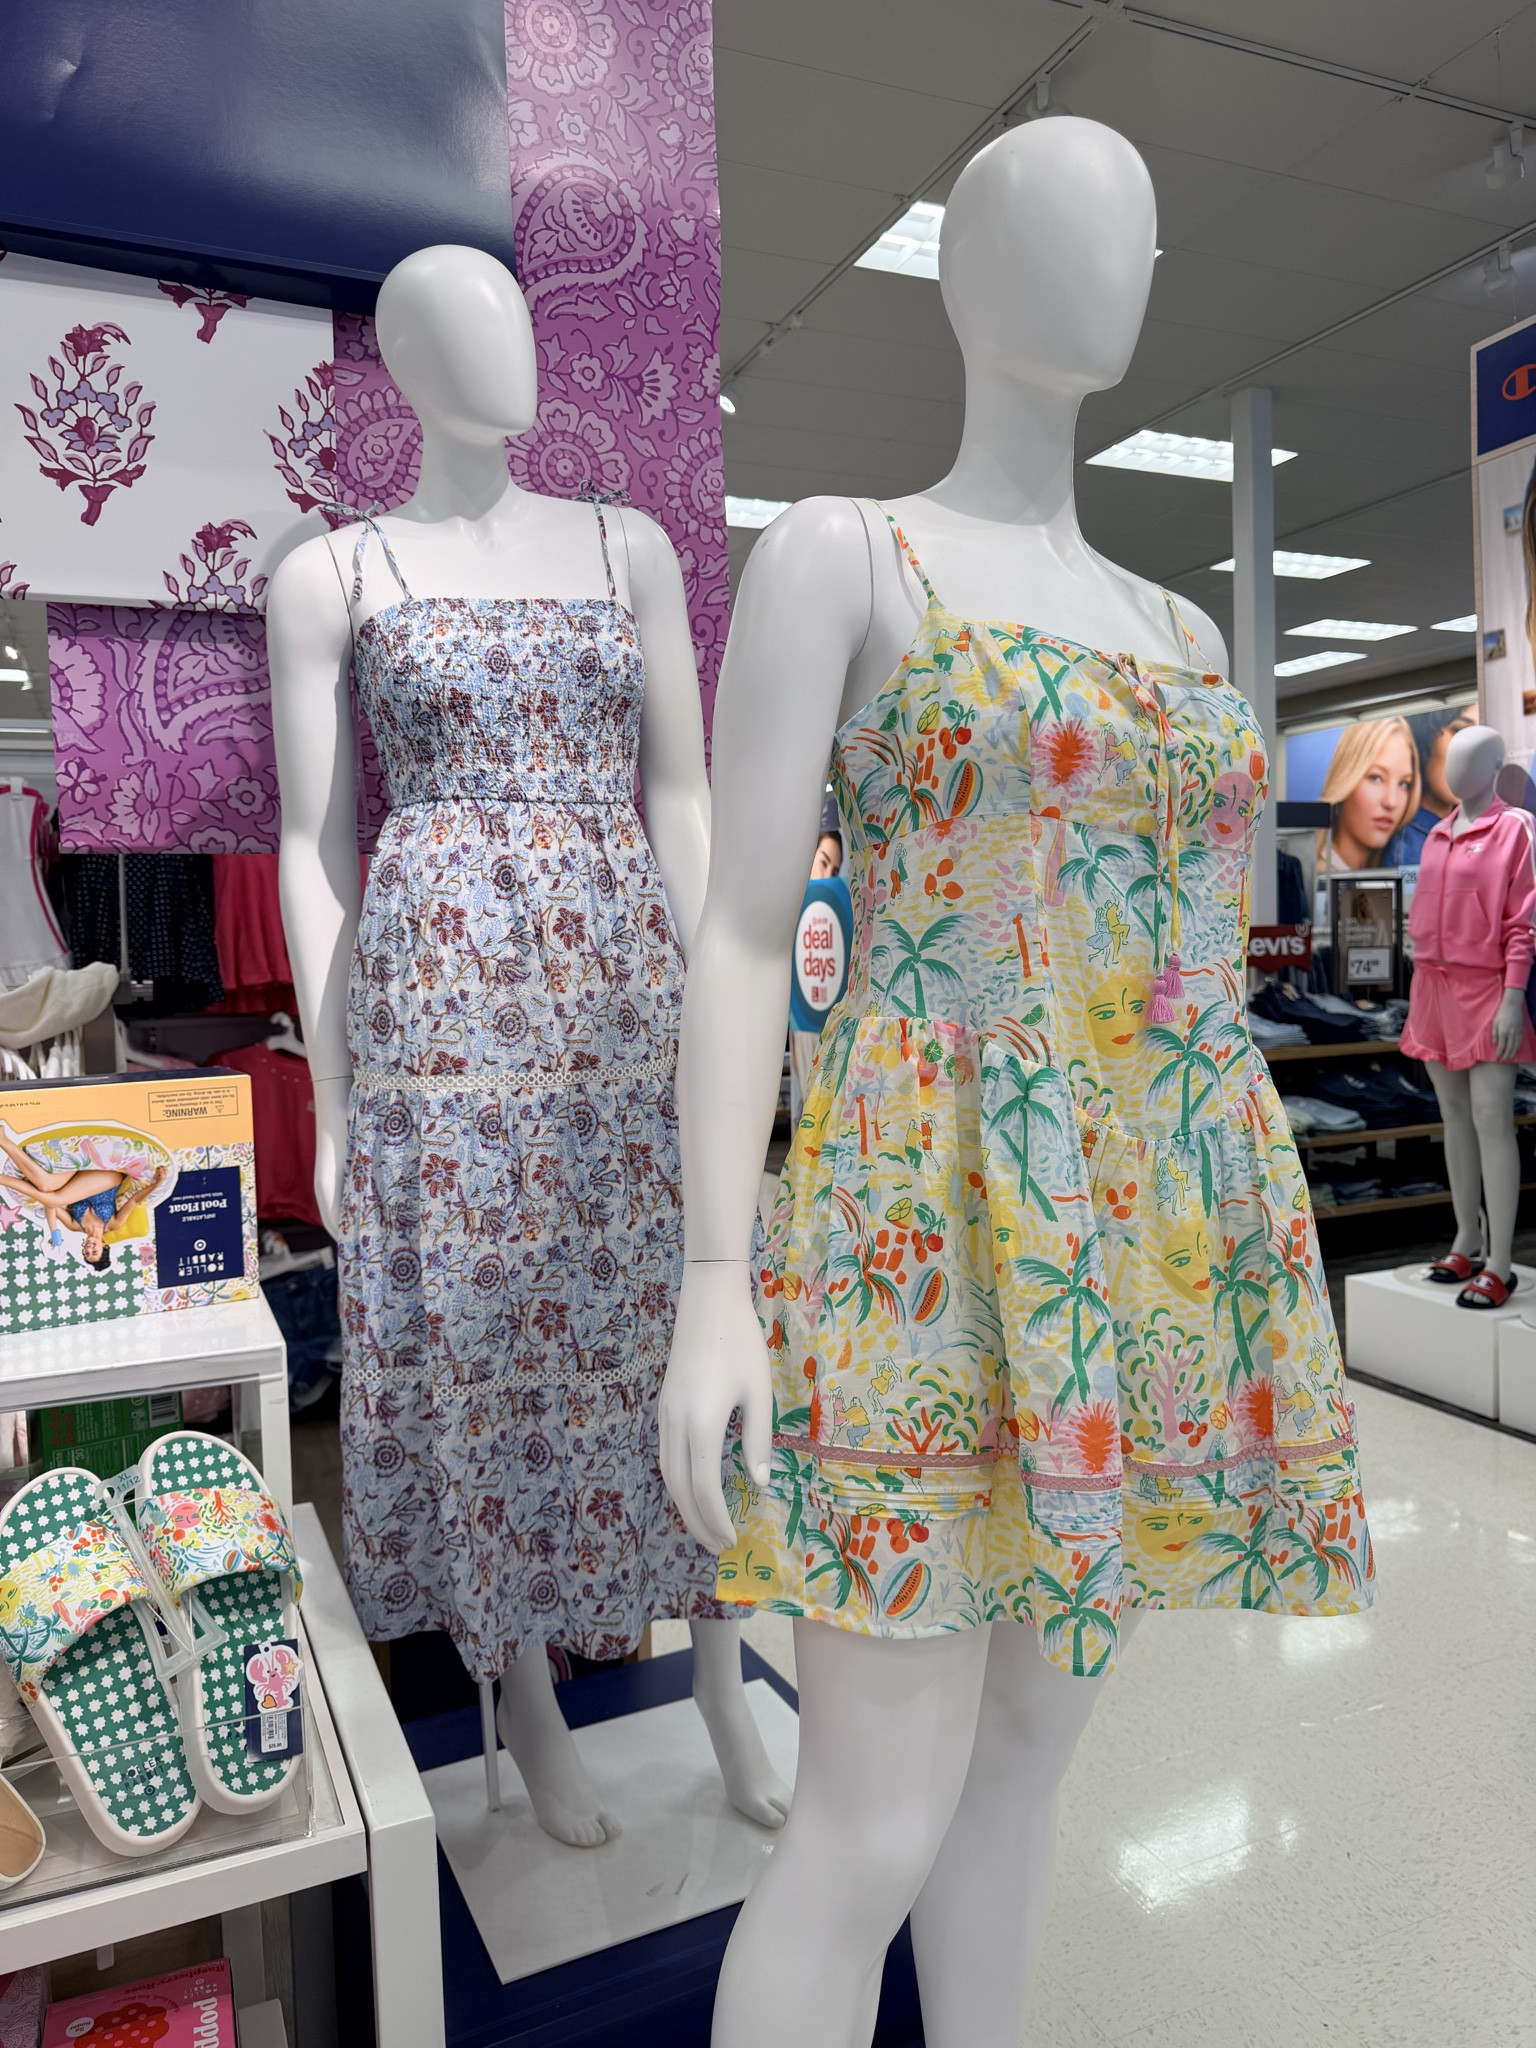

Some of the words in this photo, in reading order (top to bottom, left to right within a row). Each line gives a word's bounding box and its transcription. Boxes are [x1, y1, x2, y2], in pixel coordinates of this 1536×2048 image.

[803, 923, 833, 949] deal
[803, 952, 836, 982] days
[163, 1107, 207, 1118] WARNING:
[168, 1202, 199, 1214] Float
[201, 1198, 227, 1210] Pool
[182, 1213, 216, 1222] INFLATABLE
[178, 1252, 224, 1266] RABBIT
[178, 1262, 224, 1277] ROLLER
[117, 1475, 141, 1492] 11/12
[118, 1473, 131, 1482] XL
[121, 1756, 163, 1782] ROLLER
[124, 1765, 164, 1790] RABBIT
